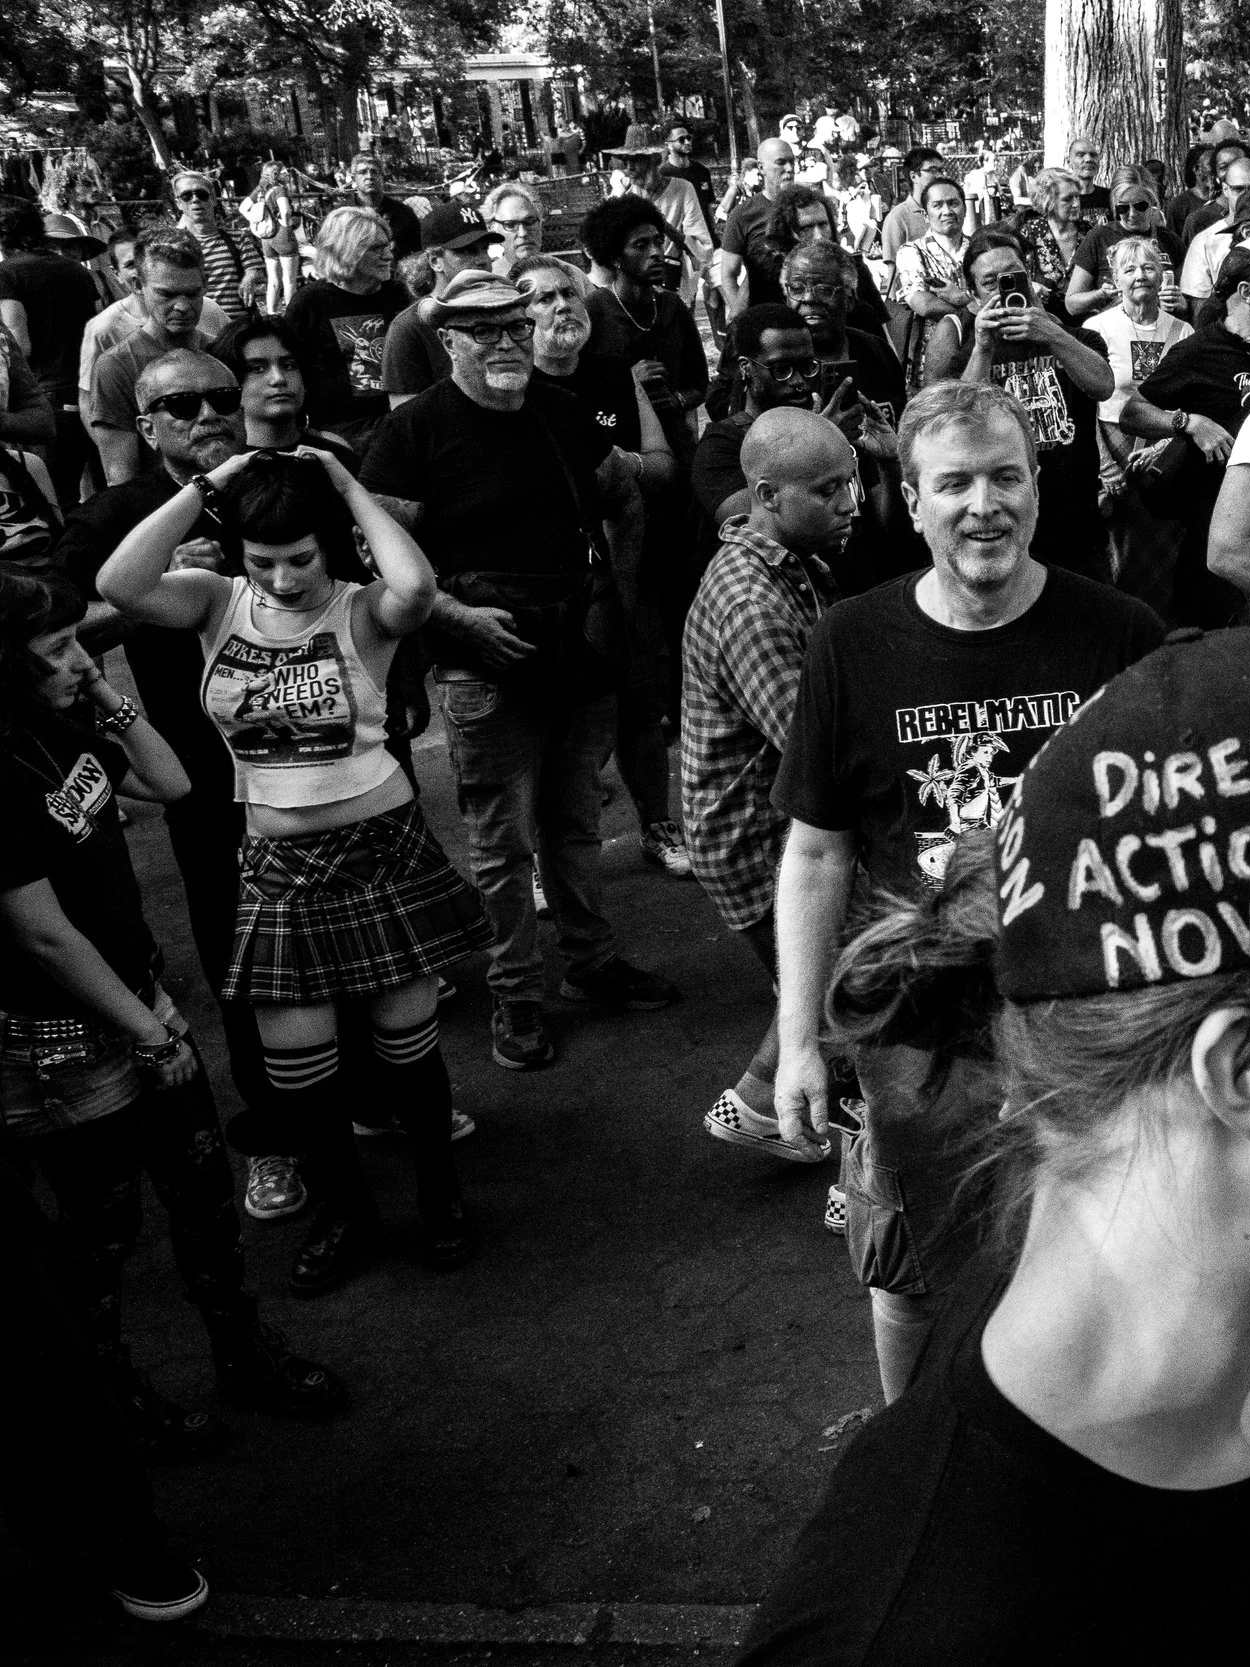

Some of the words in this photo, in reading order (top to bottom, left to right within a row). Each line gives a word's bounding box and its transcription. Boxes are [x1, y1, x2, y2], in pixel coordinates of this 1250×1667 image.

[460, 207, 481, 224] NY
[273, 663, 320, 687] WHO
[266, 677, 341, 704] NEEDS
[895, 690, 1081, 743] REBELMATIC
